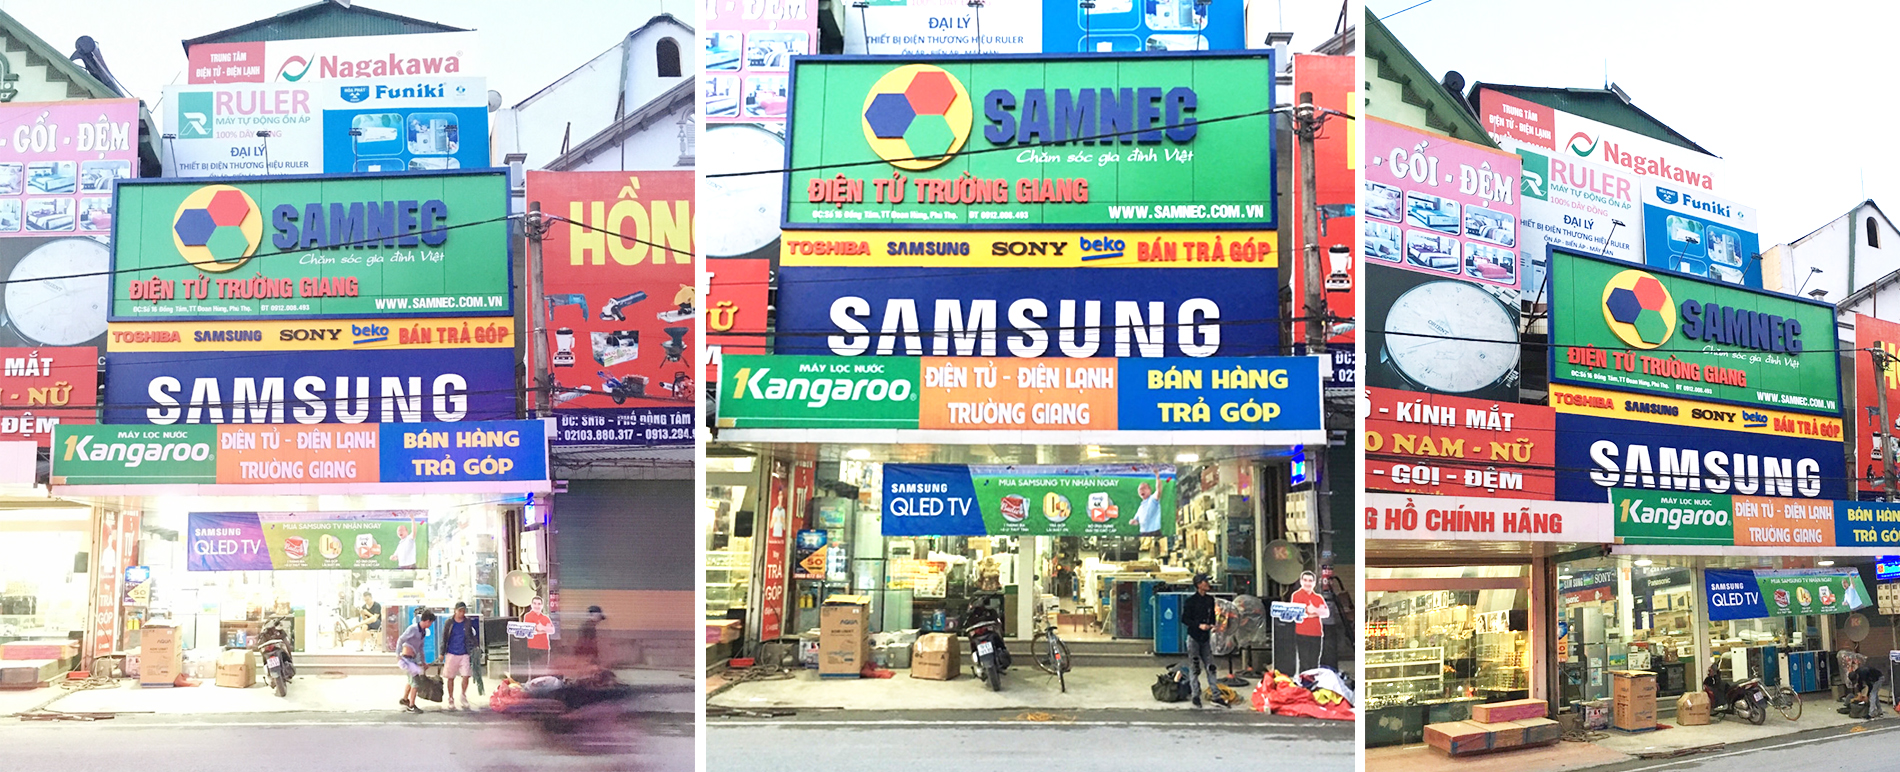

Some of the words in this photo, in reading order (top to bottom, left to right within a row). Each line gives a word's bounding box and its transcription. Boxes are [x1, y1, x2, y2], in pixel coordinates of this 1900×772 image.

[928, 17, 952, 32] ĐẠI
[958, 14, 970, 28] LÝ
[210, 53, 231, 62] TRUNG
[233, 51, 246, 62] TÂM
[320, 53, 460, 78] Nagakawa
[216, 90, 310, 115] RULER
[376, 84, 444, 98] Funiki
[984, 87, 1197, 146] SAMNEC
[13, 110, 57, 153] GỐI
[77, 114, 130, 159] ĐỆM
[230, 147, 250, 158] ĐẠI
[254, 144, 266, 156] LÝ
[1016, 150, 1061, 163] Chăm
[1066, 150, 1093, 163] sóc
[1098, 152, 1120, 166] gia
[1126, 148, 1158, 162] đình
[1164, 148, 1194, 163] Việt
[180, 161, 200, 170] THIẾT
[210, 160, 228, 170] ĐIỆN
[230, 162, 264, 170] THƯƠNG
[267, 160, 284, 169] HIỆU
[1389, 140, 1439, 187] GỐI
[1460, 161, 1514, 208] ĐỆM
[1604, 140, 1713, 190] Nagakawa
[808, 173, 864, 208] ĐIỆN
[873, 171, 908, 203] TỬ
[914, 171, 1008, 204] TRƯỜNG
[1016, 178, 1088, 204] GIANG
[1551, 158, 1632, 202] RULER
[1550, 183, 1568, 194] MÁY
[1570, 189, 1582, 198] TỰ
[1584, 192, 1606, 205] ĐỘNG
[1622, 202, 1632, 210] ÁP
[1550, 196, 1570, 208] 100%
[1682, 193, 1731, 218] Funiki
[1108, 204, 1264, 218] WWW.SAMNEC.COM.VN
[272, 200, 448, 250] SAMNEC
[787, 240, 870, 256] TOSHIBA
[887, 241, 970, 256] SAMSUNG
[992, 242, 1068, 256] SONY
[1080, 236, 1125, 250] beko
[1137, 236, 1176, 262] BÁN
[1183, 235, 1225, 262] TRẢ
[1230, 236, 1271, 262] GÓP
[129, 276, 174, 304] ĐIỆN
[182, 274, 210, 300] TỬ
[216, 272, 293, 299] TRƯỜNG
[299, 276, 358, 298] GIANG
[375, 296, 502, 310] WWW.SAMNEC.COM.VN
[113, 330, 181, 342] TOSHIBA
[194, 330, 262, 342] SAMSUNG
[280, 329, 342, 341] SONY
[352, 324, 389, 336] beko
[399, 324, 431, 344] BÁN
[436, 322, 470, 344] TRẢ
[474, 322, 508, 343] GÓP
[828, 296, 1220, 358] SAMSUNG
[1681, 299, 1803, 356] SAMNEC
[5, 350, 54, 376] MẮT
[800, 363, 826, 373] MÁY
[830, 364, 850, 374] LỌC
[854, 362, 884, 373] NƯỚC
[1567, 342, 1607, 371] ĐIỆN
[1612, 350, 1636, 372] TỬ
[1640, 354, 1700, 382] TRƯỜNG
[1704, 365, 1747, 388] GIANG
[732, 368, 910, 408] 1Kangaroo
[925, 362, 968, 393] ĐIỆN
[1017, 362, 1060, 394] ĐIỆN
[1066, 367, 1114, 394] LẠNH
[1148, 366, 1202, 390] BÁN
[1212, 365, 1288, 390] HÀNG
[28, 381, 73, 406] NỮ
[146, 374, 467, 425] SAMSUNG
[1757, 392, 1836, 410] WWW.SAMNEC.COM.VN
[670, 412, 690, 424] TÂM
[948, 398, 1026, 424] TRƯỜNG
[1032, 403, 1090, 424] GIANG
[1157, 396, 1211, 422] TRẢ
[1220, 398, 1281, 422] GÓP
[1396, 399, 1456, 428] KÍNH
[1466, 404, 1514, 432] MẮT
[1554, 392, 1614, 410] TOSHIBA
[1624, 400, 1679, 417] SAMSUNG
[1692, 408, 1736, 422] SONY
[1742, 410, 1768, 423] beko
[1774, 415, 1795, 434] BÁN
[1797, 418, 1818, 436] TRẢ
[1820, 420, 1840, 438] GÓP
[1, 412, 60, 437] ĐỆM
[221, 428, 256, 454] ĐIỆN
[296, 428, 332, 454] ĐIỆN
[336, 431, 376, 453] LẠNH
[404, 428, 448, 449] BÁN
[456, 428, 520, 448] HÀNG
[1392, 433, 1466, 458] NAM
[1490, 438, 1534, 463] NỮ
[64, 435, 210, 468] 1Kangaroo
[412, 454, 456, 476] TRẢ
[464, 450, 514, 475] GÓP
[240, 458, 304, 479] TRƯỜNG
[308, 461, 356, 478] GIANG
[1464, 466, 1523, 492] ĐỆM
[1590, 440, 1822, 497] SAMSUNG
[891, 484, 948, 493] SAMSUNG
[1072, 478, 1095, 489] NHẬN
[890, 498, 944, 516] QLED
[947, 498, 972, 516] TV
[1385, 498, 1418, 531] HỒ
[1426, 504, 1495, 533] CHÍNH
[1502, 507, 1562, 534] HÃNG
[1620, 499, 1728, 530] 1Kangaroo
[1735, 499, 1758, 520] ĐIỆN
[1784, 502, 1807, 522] ĐIỆN
[1808, 506, 1832, 522] LẠNH
[194, 528, 242, 537] SAMSUNG
[1749, 525, 1791, 543] TRƯỜNG
[1793, 528, 1822, 543] GIANG
[194, 540, 238, 556] QLED
[242, 540, 261, 554] TV
[768, 561, 782, 579] TRẢ
[1594, 572, 1611, 584] SONY
[1648, 577, 1671, 586] Panasonic
[766, 586, 782, 600] GÓP
[1711, 582, 1744, 590] SAMSUNG
[1712, 592, 1744, 607] QLED
[1746, 592, 1758, 605] TV
